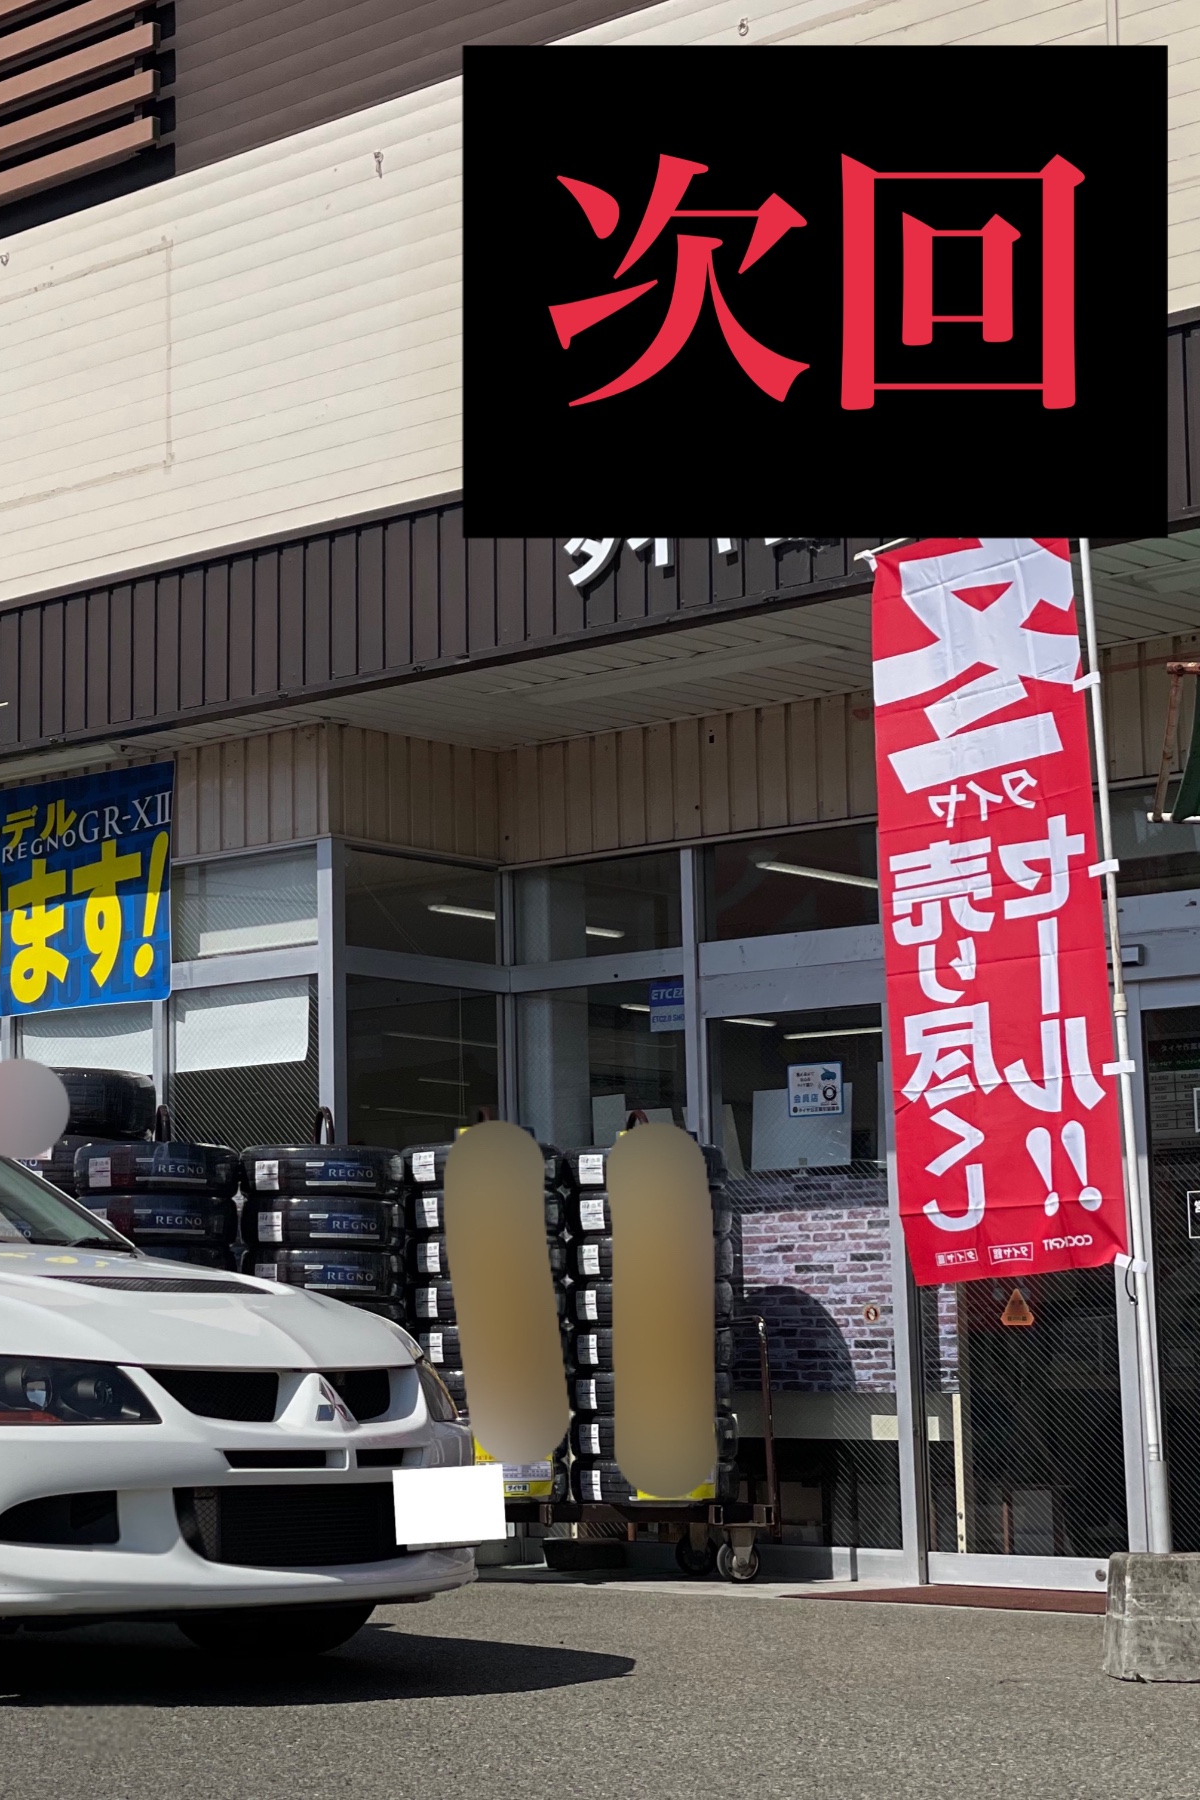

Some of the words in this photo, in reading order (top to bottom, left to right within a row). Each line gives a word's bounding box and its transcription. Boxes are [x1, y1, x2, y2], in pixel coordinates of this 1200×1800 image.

[793, 1093, 819, 1104] 会員店
[158, 1164, 205, 1175] REGNO
[328, 1168, 375, 1179] REGNO
[155, 1215, 203, 1226] REGNO
[332, 1220, 378, 1231] REGNO
[327, 1271, 375, 1282] REGNO
